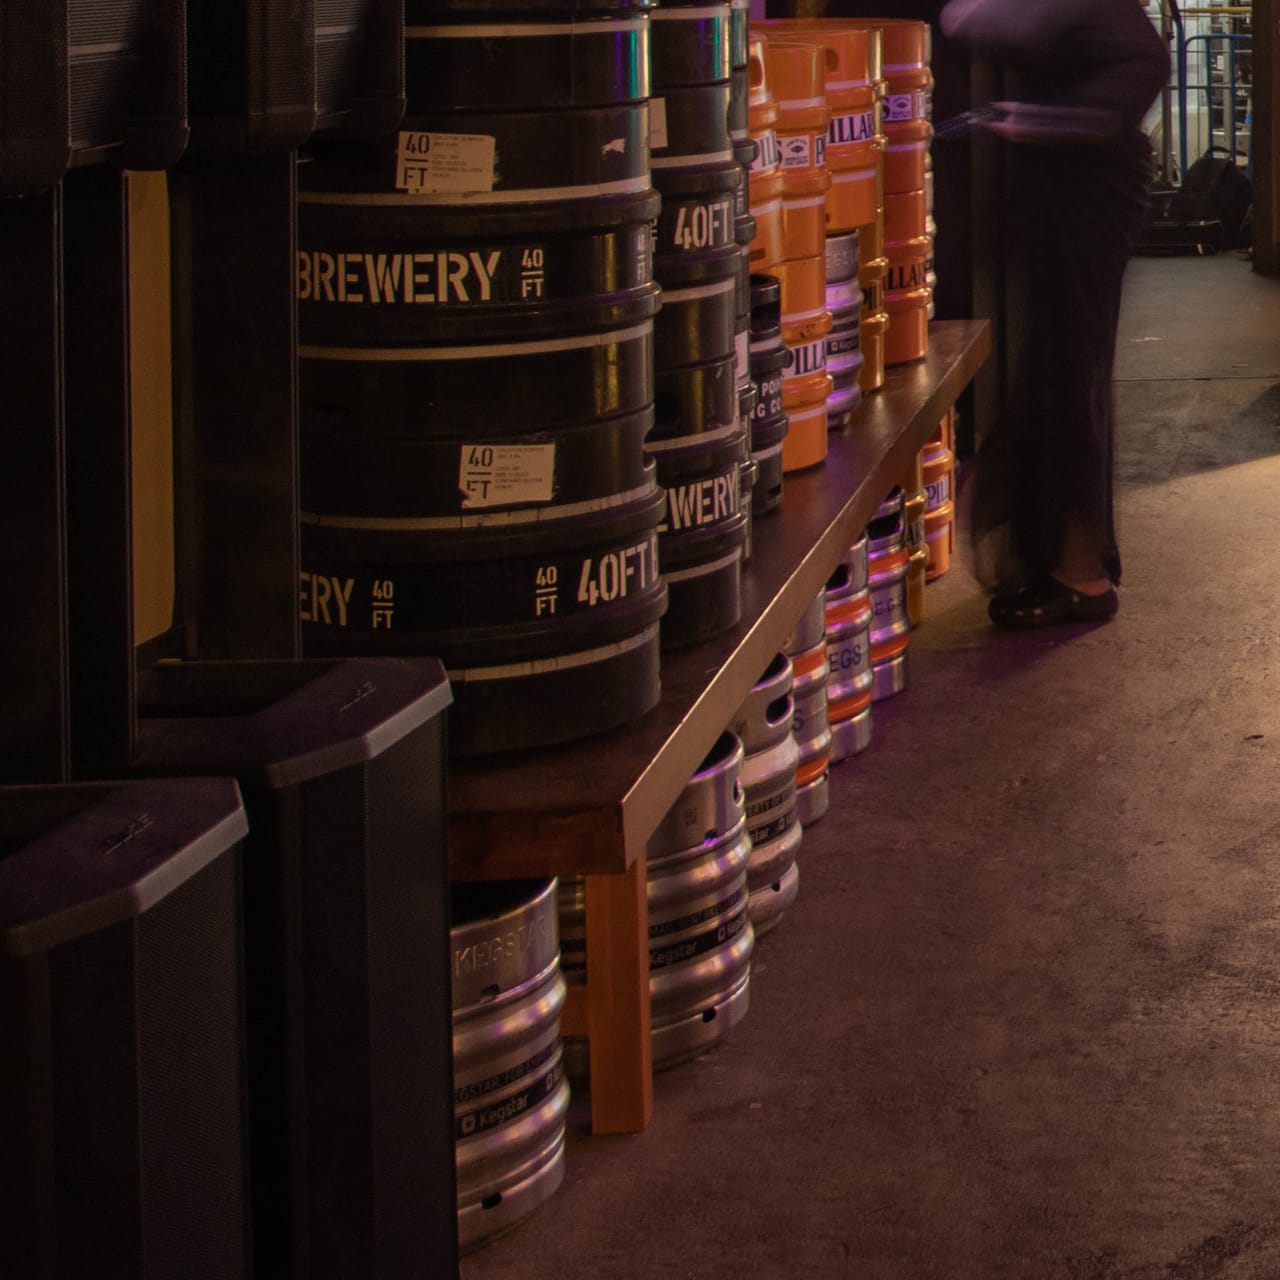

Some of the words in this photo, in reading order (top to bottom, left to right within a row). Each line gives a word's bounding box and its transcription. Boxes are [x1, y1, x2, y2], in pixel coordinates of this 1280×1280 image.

[405, 133, 430, 154] 40
[403, 166, 429, 187] FT
[674, 200, 731, 250] 40FT
[521, 248, 544, 268] 40
[296, 250, 502, 303] BREWERY
[521, 277, 544, 298] FT
[468, 447, 494, 468] 40
[466, 480, 492, 500] FT
[535, 566, 558, 587] 40
[577, 542, 649, 607] 40FT
[372, 580, 393, 600] 40
[535, 594, 558, 617] FT
[372, 609, 394, 629] FT
[479, 1094, 528, 1128] Kegstar
